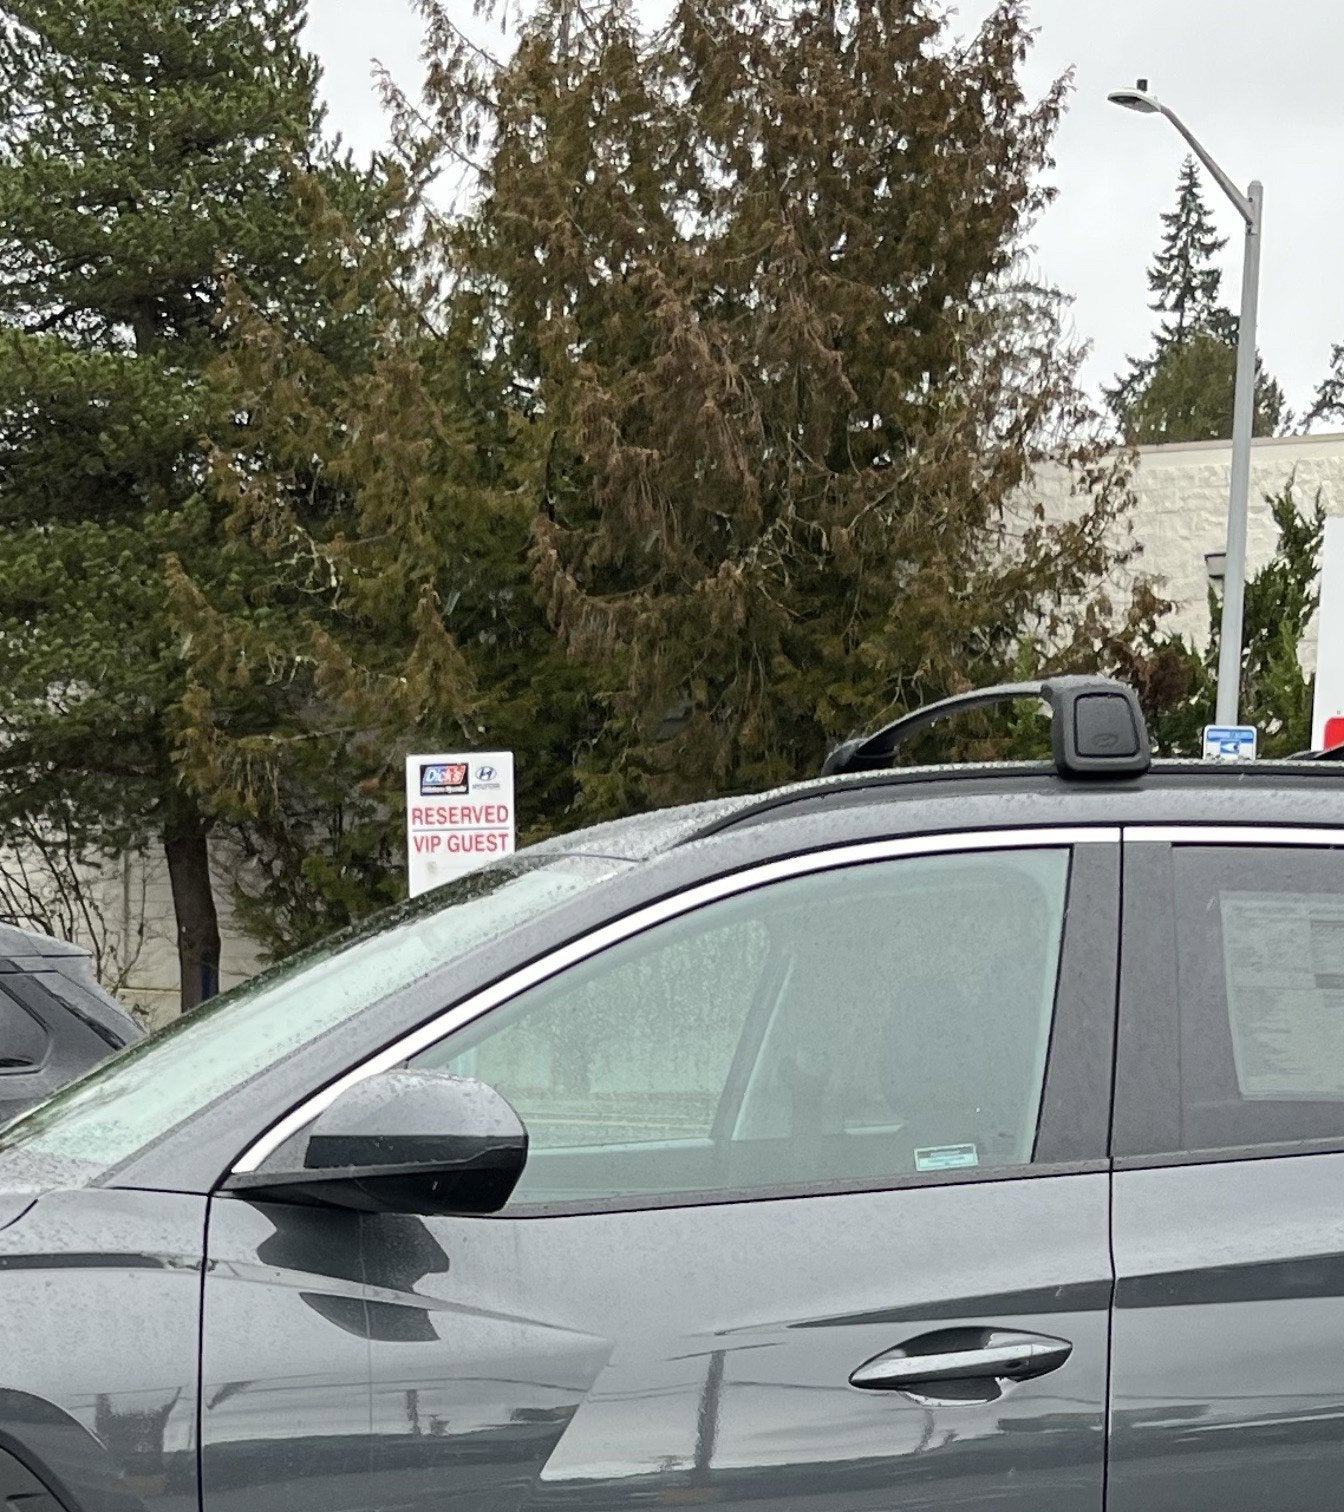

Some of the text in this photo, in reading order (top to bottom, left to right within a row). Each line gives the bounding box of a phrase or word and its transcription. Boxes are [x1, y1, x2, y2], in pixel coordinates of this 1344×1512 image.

[411, 804, 509, 825] RESERVED
[413, 833, 509, 853] VIP GUEST
